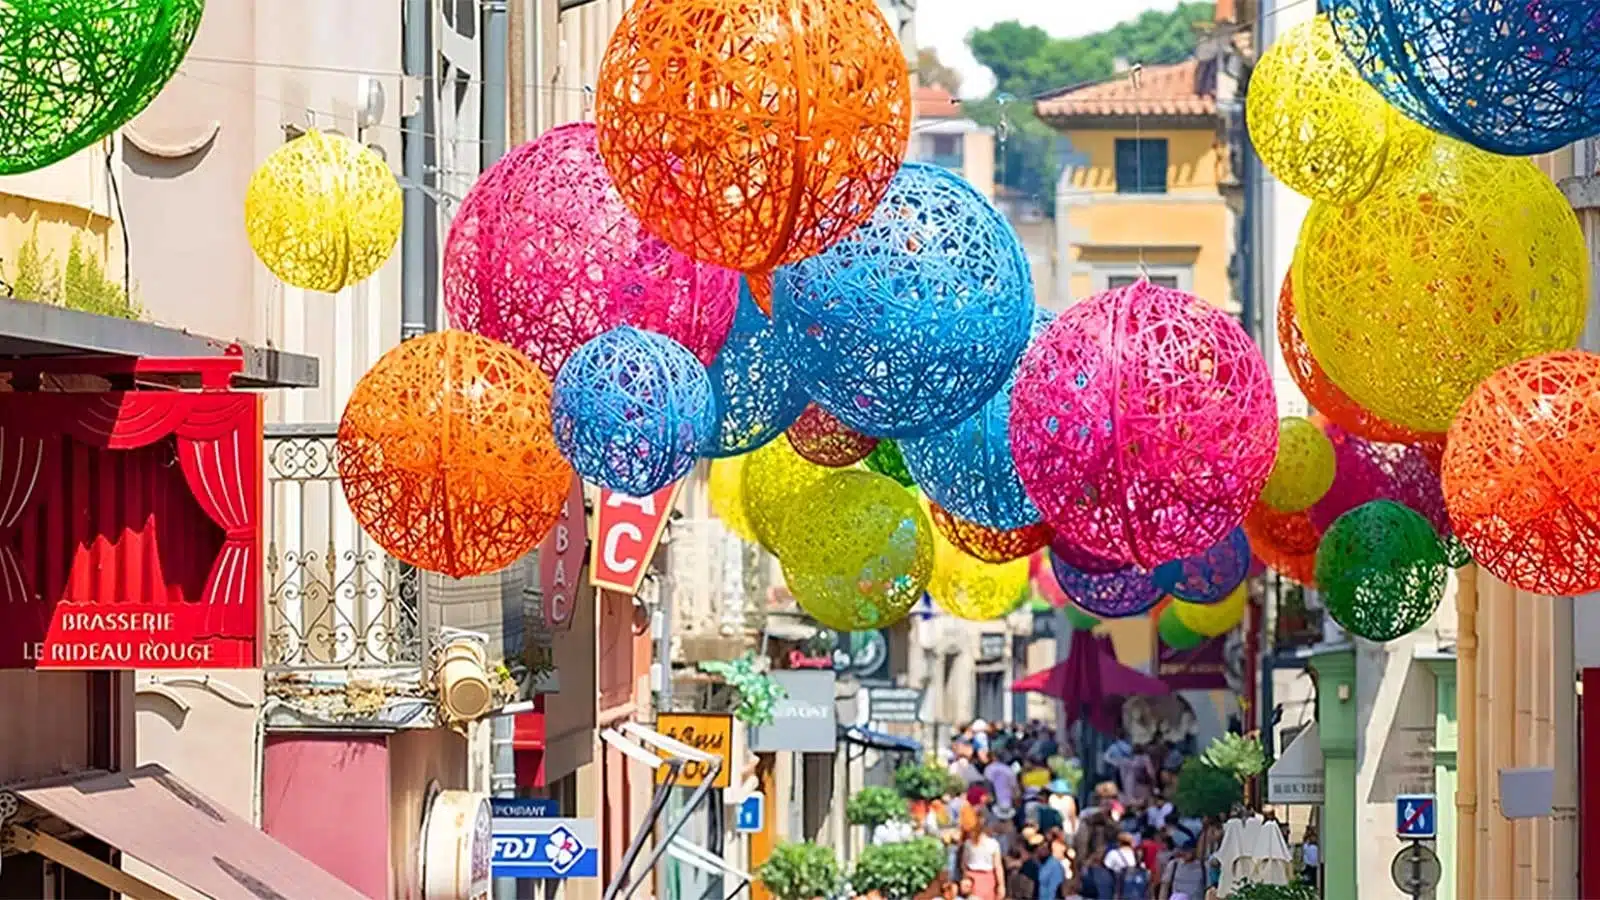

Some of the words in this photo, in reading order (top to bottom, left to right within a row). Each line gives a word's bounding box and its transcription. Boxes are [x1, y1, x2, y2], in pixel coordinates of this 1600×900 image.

[61, 613, 175, 631] BRASSERIE
[23, 642, 44, 660] LE
[51, 642, 132, 661] RIDEAU
[138, 642, 214, 661] ROUGE
[491, 837, 537, 859] FDJ
